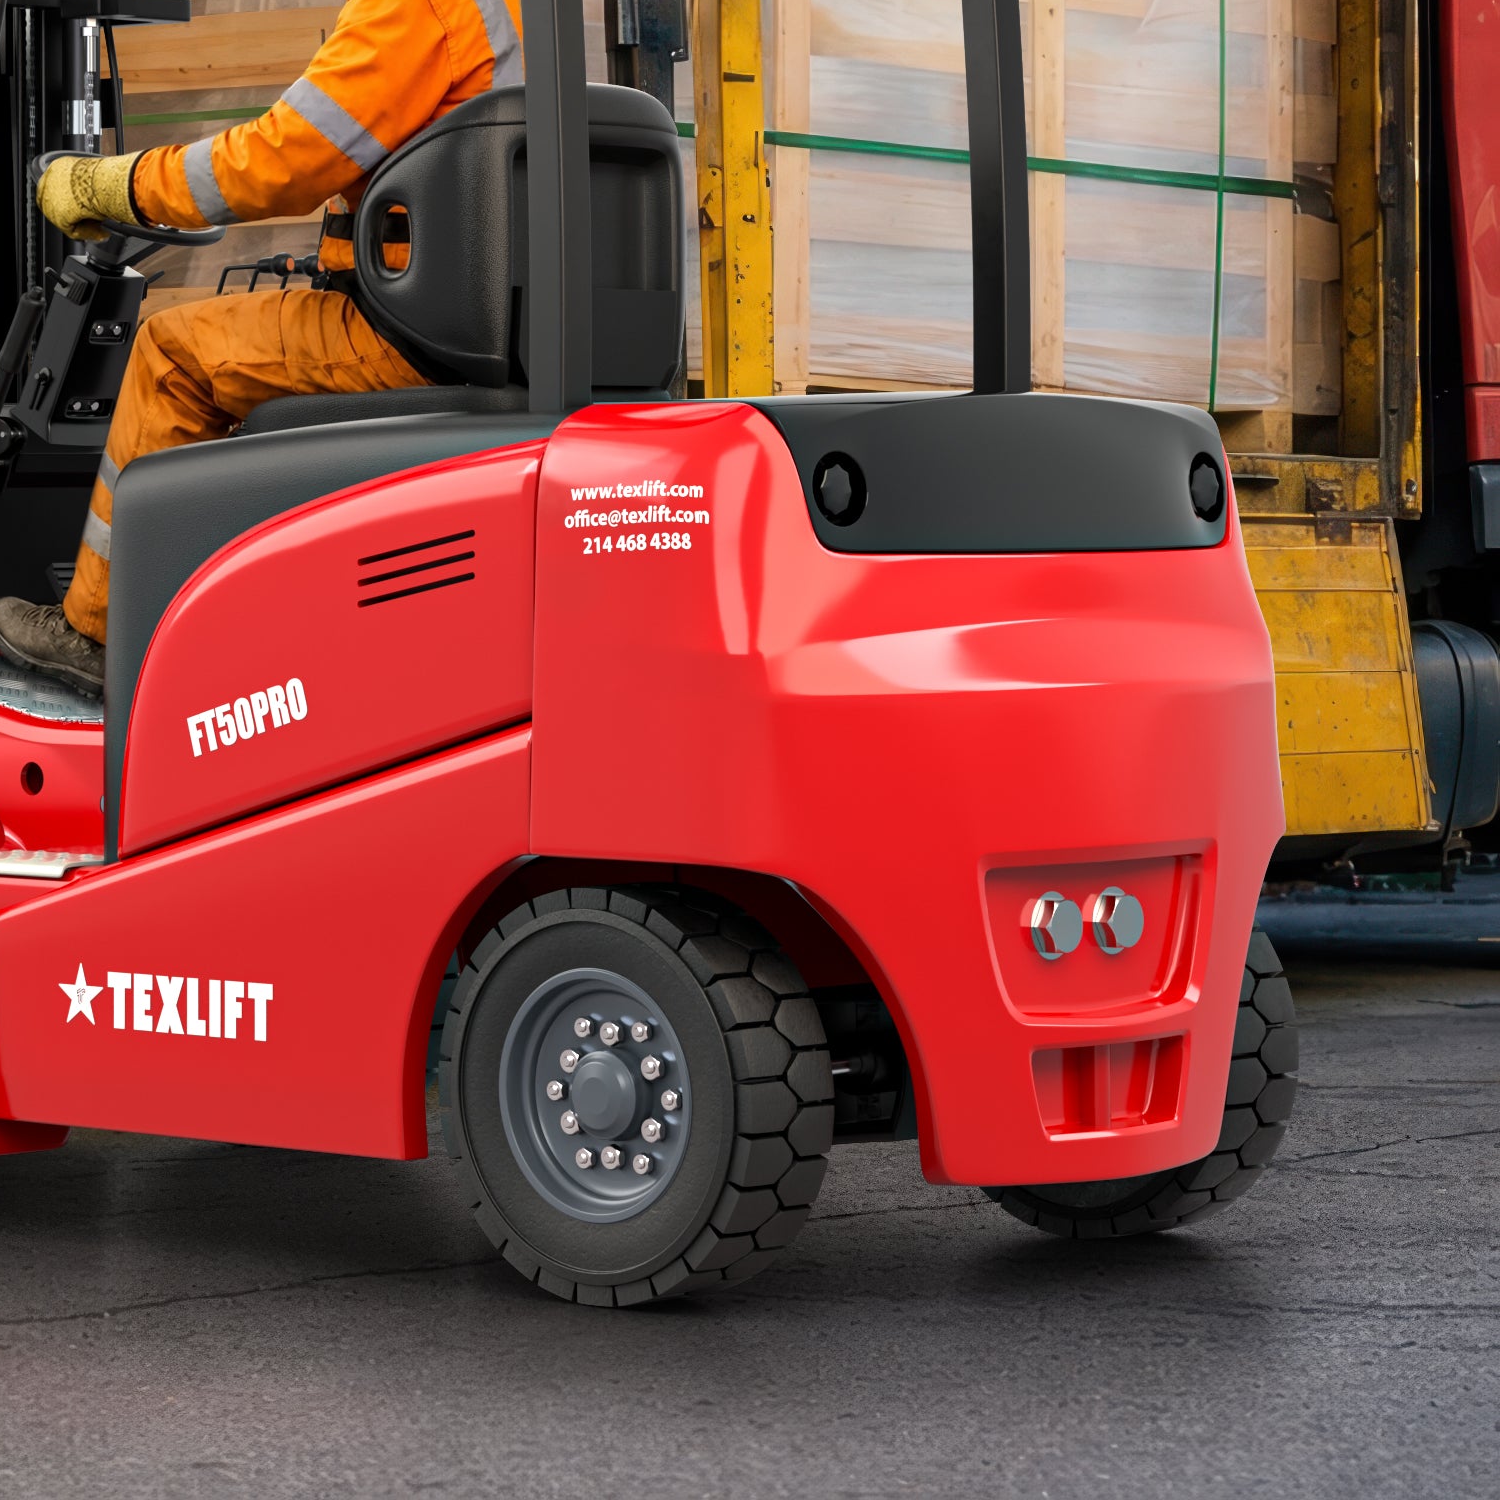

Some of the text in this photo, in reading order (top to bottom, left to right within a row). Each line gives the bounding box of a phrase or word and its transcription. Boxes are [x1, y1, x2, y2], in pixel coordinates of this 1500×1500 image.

[570, 479, 704, 501] www.texlift.com
[563, 504, 710, 529] office@texlift.com
[582, 532, 692, 555] 214 468 4388
[186, 677, 308, 758] FT50PRO
[106, 971, 274, 1042] TEXLIFT
